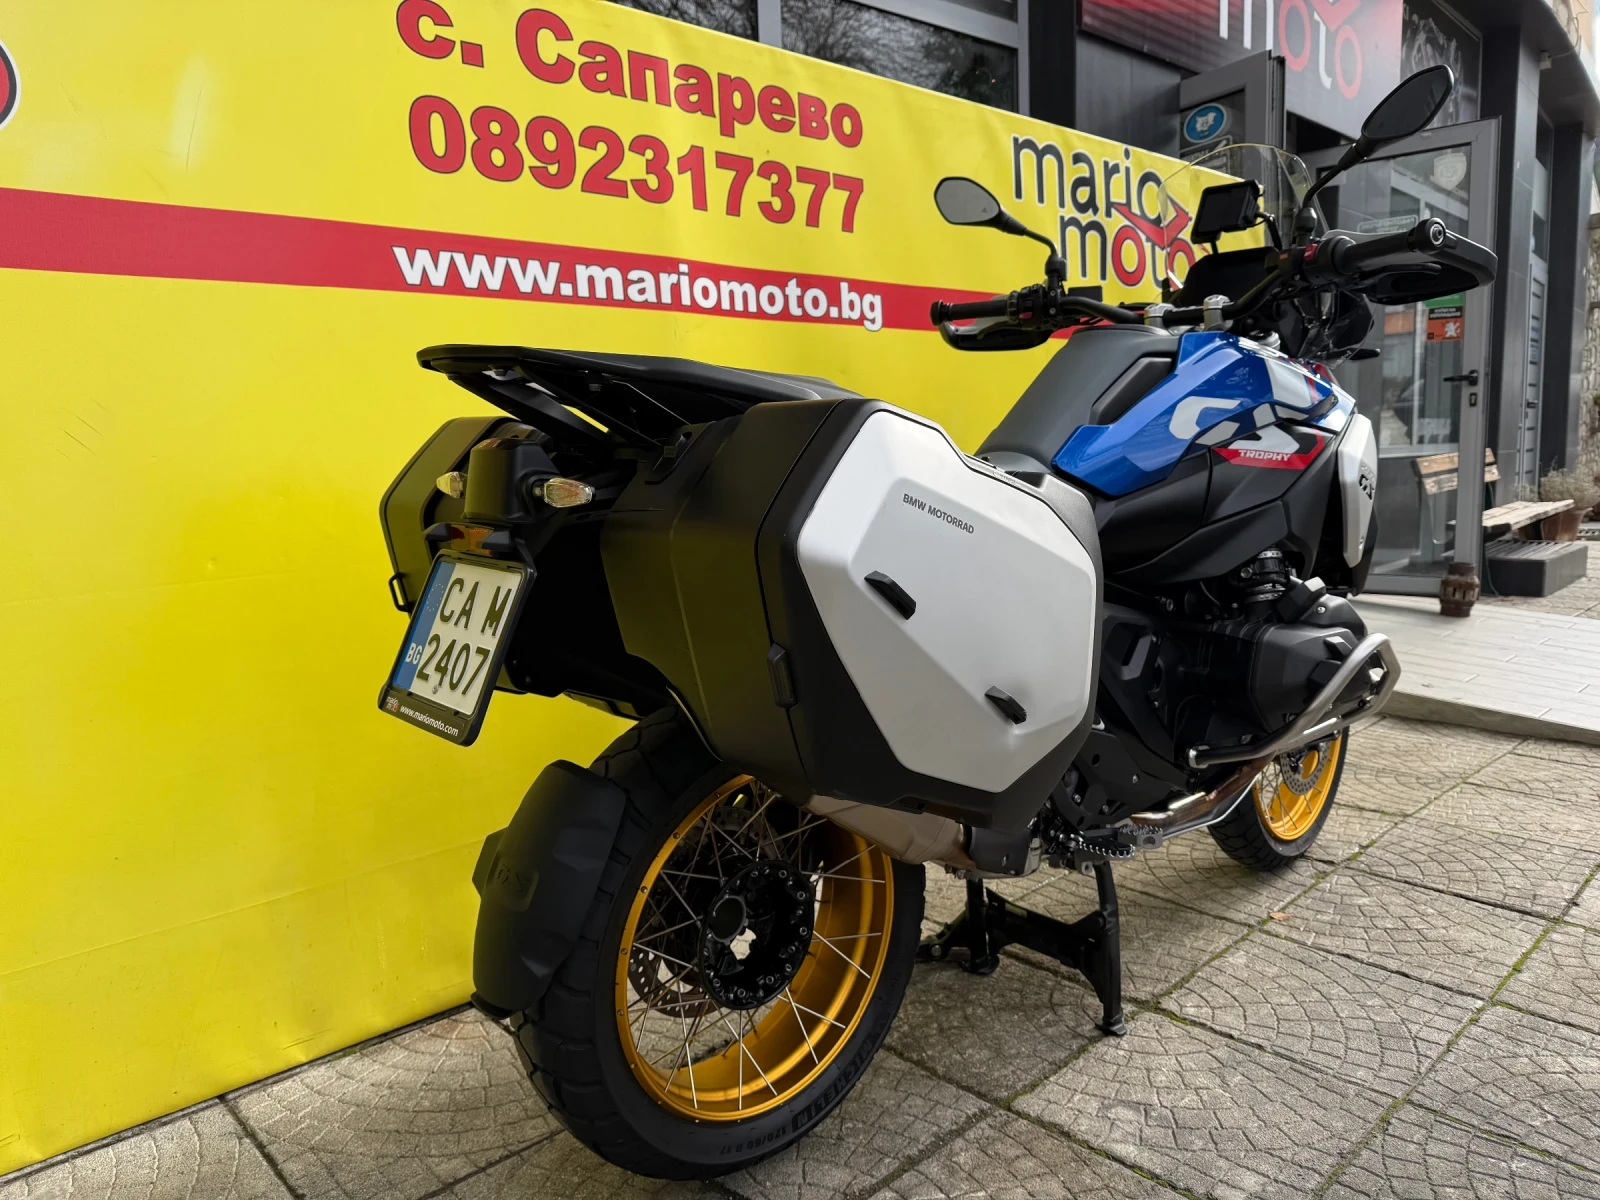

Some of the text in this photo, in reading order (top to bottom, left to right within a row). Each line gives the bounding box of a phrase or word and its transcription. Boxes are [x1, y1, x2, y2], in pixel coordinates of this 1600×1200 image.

[515, 8, 864, 148] Сапарево
[408, 95, 865, 234] 0892317377
[1012, 135, 1168, 228] mario
[392, 245, 884, 333] www.mariomoto.bg
[1239, 450, 1291, 462] TROPHY
[903, 493, 974, 534] BMW MOTORRAD
[439, 577, 512, 637] CA M
[405, 642, 423, 665] BG
[416, 633, 491, 695] 2407
[400, 705, 459, 737] www.mariomoto.com
[796, 1038, 873, 1128] MICHELIN
